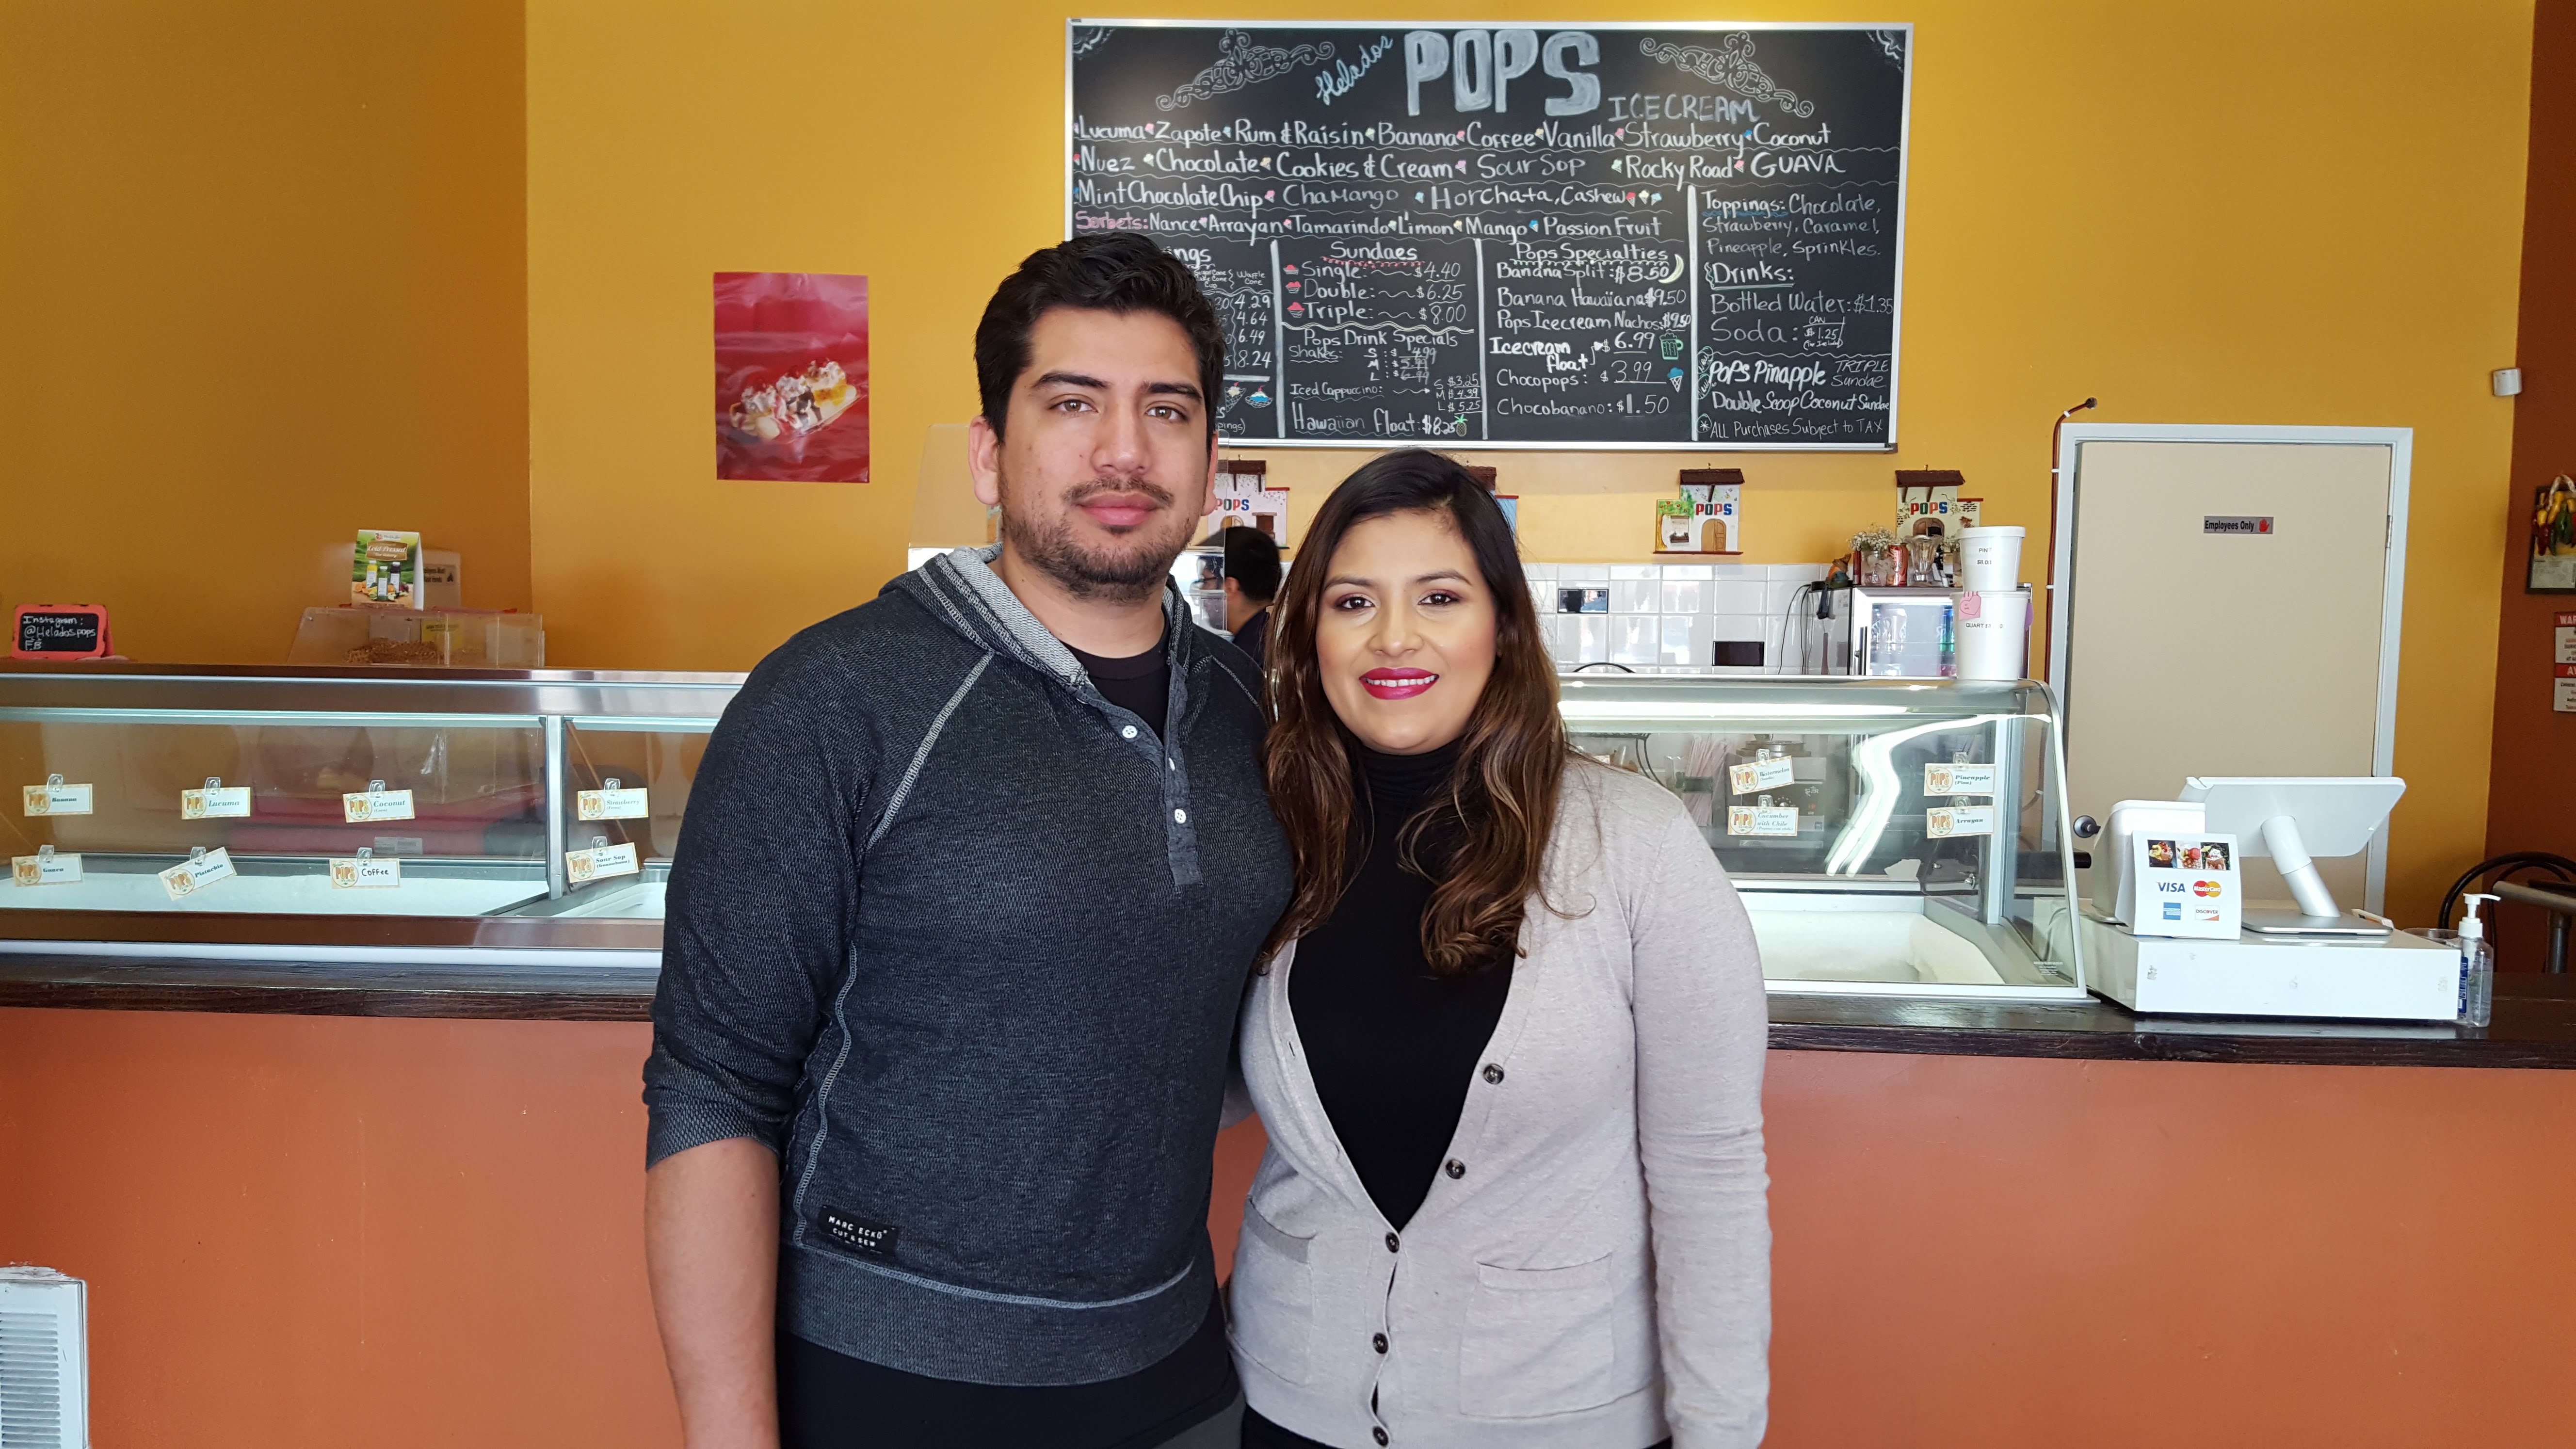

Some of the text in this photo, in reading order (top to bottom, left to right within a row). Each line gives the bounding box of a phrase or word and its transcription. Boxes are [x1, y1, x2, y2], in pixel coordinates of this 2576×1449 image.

[1404, 29, 1601, 116] POPS
[1079, 114, 1831, 160] Lucuma Zapote Rum & Raisin Banana Coffee Vanilla Strawberry Coconut
[1081, 145, 1846, 192] Nuez Chocolate Cookies & Cream Sour Sop Rocky Road GUAVA
[1561, 186, 1626, 206] Cashew
[1075, 210, 1149, 230] Sorbets:
[1149, 212, 1200, 232] Nance
[1208, 214, 1284, 246] Arrayan
[1289, 214, 1390, 235] Tamarindo
[1465, 216, 1528, 245] Mango
[1544, 217, 1612, 236] Passion
[1615, 216, 1661, 236] Fruit
[1331, 241, 1418, 260] Sundaes
[1516, 242, 1668, 268] Pops Specialties
[1413, 261, 1461, 279] $4.40
[1497, 262, 1562, 279] Banana
[1416, 284, 1466, 300] $6.25
[1497, 287, 1567, 307] Banana
[1711, 290, 1782, 314] Bottled
[1419, 304, 1466, 324] $8.00
[1497, 309, 1531, 335] Pops
[1304, 329, 1458, 352] Pops Drink Specials
[1237, 350, 1272, 369] 8.24
[1835, 360, 1889, 373] TRIPLE
[1290, 382, 1319, 396] Iced
[1712, 389, 1762, 414] Double
[1800, 390, 1858, 411] Coconut
[1858, 394, 1890, 411] Sundae
[1291, 401, 1365, 431] Hawaiian
[1734, 420, 1789, 438] Purchases
[1791, 418, 1838, 440] Subject
[1842, 420, 1853, 435] to
[1858, 419, 1883, 434] TAX
[1695, 503, 1732, 516] POPS
[1910, 501, 1948, 515] POPS
[2205, 520, 2254, 532] Employees Only
[361, 868, 389, 877] Coffee
[2157, 881, 2186, 893] VISA
[828, 1215, 854, 1231] MARC
[833, 1227, 849, 1238] CUT
[857, 1237, 876, 1247] SEW
